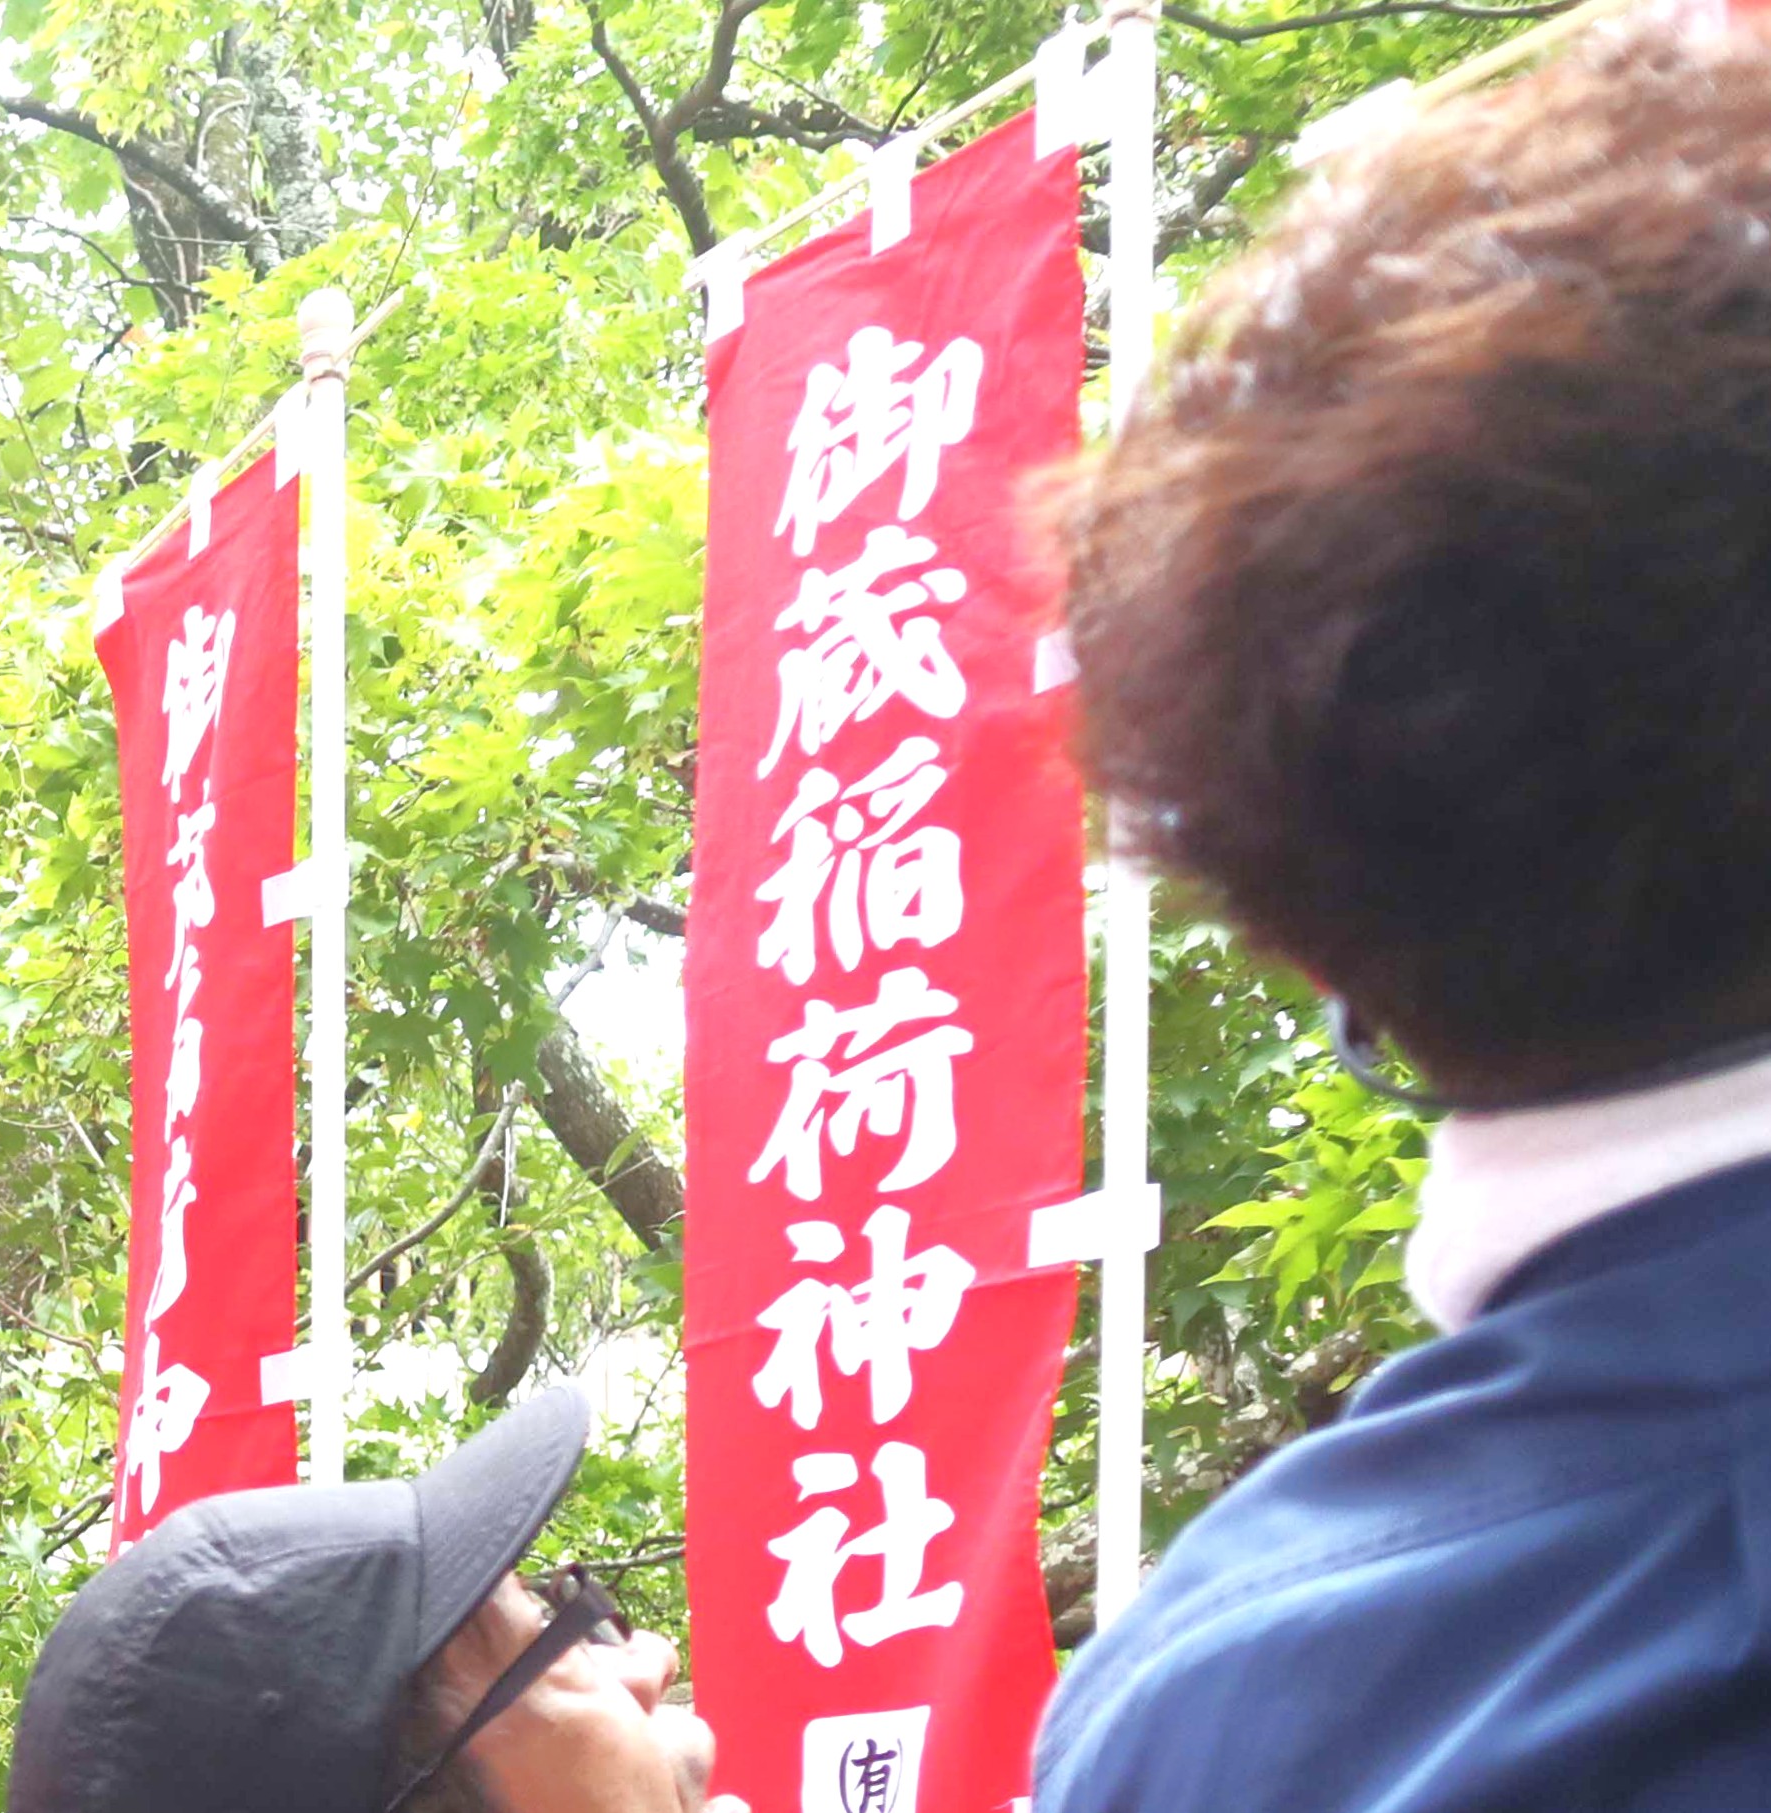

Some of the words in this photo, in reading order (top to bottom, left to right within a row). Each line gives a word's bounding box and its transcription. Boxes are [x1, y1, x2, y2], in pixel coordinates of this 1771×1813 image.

[747, 325, 985, 1668] 御蔵稲荷神社
